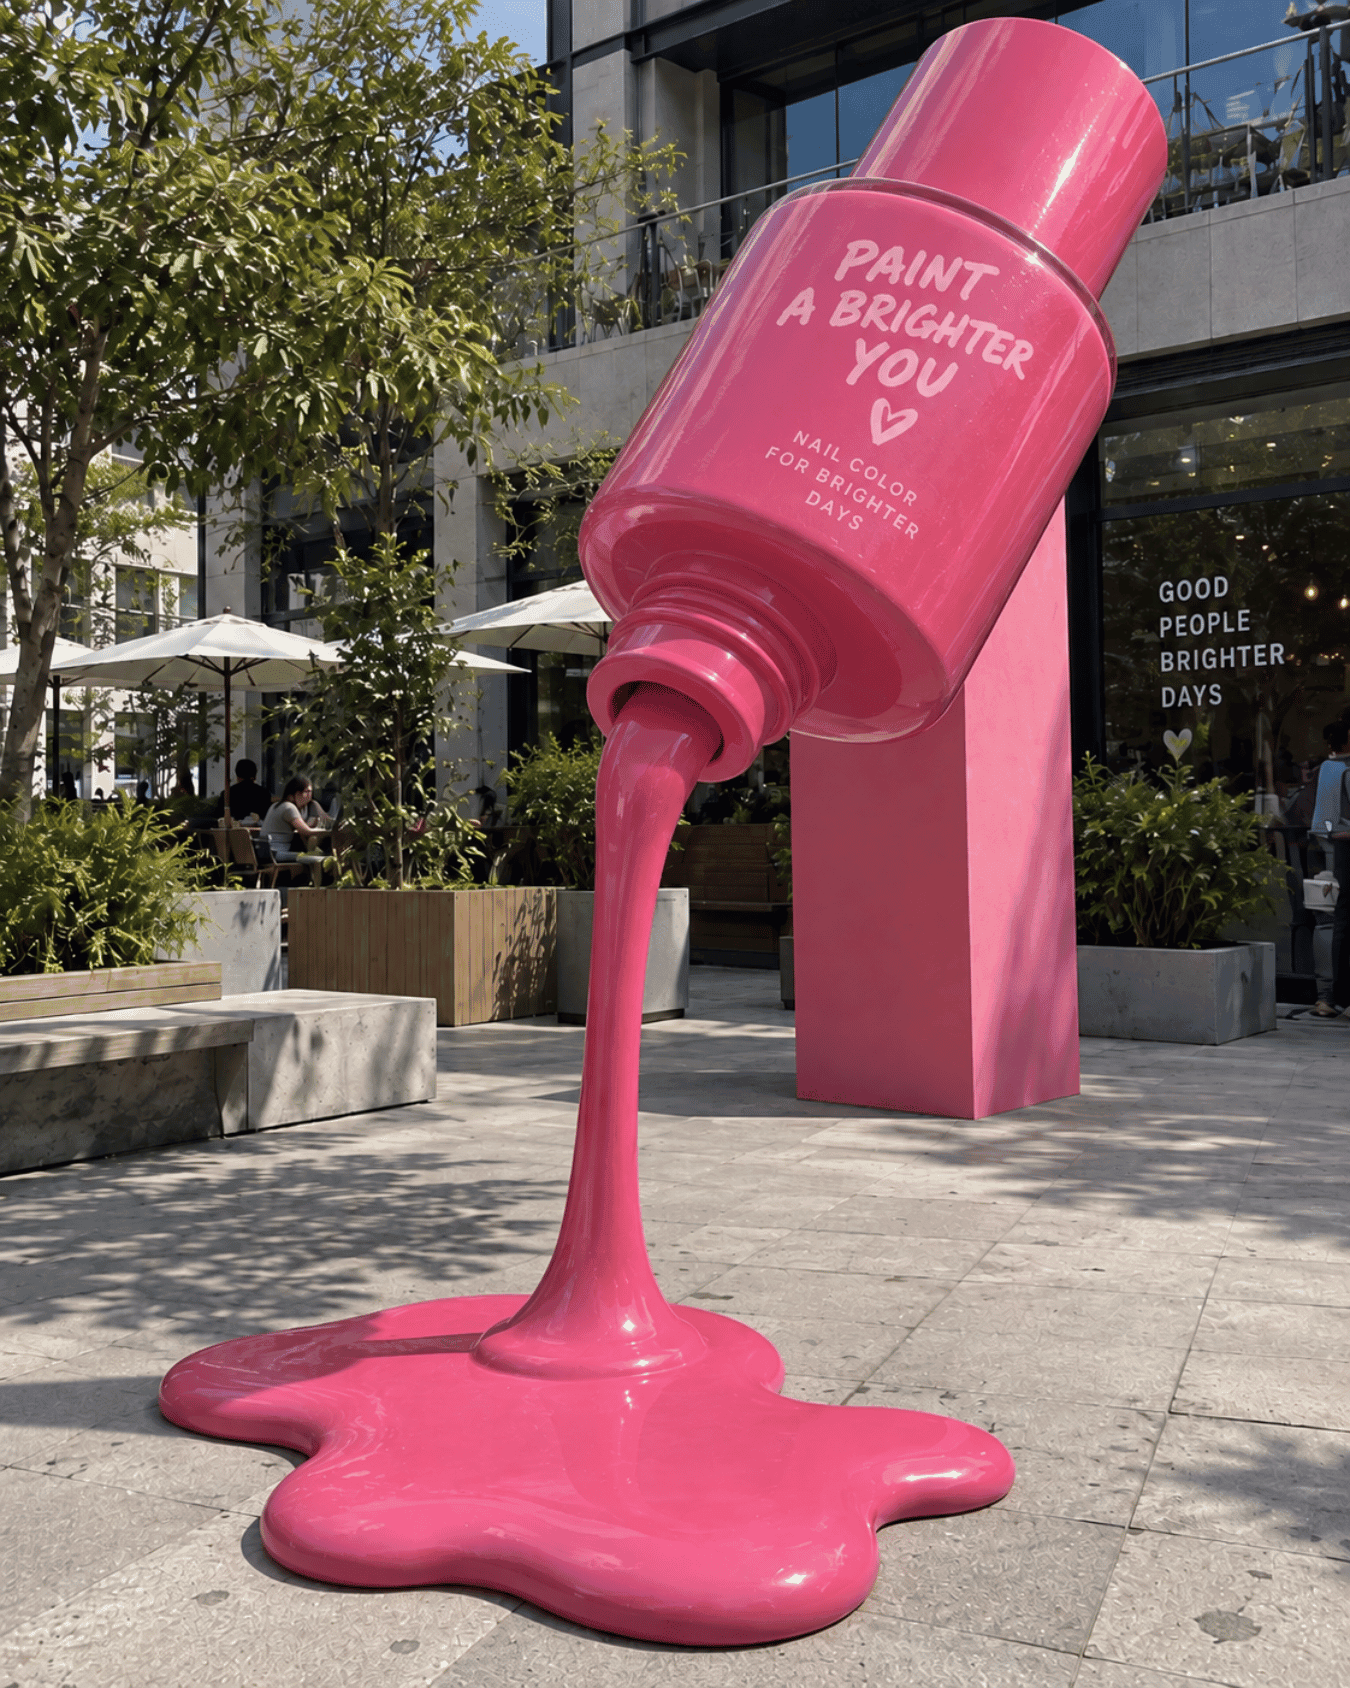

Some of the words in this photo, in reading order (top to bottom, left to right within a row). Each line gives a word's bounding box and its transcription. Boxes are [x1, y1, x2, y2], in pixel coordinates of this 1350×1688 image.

[834, 239, 1000, 301] PAINT
[776, 287, 816, 326] A
[829, 290, 1034, 380] BRIGHTER
[845, 338, 959, 398] YOU
[765, 446, 810, 474] FOR
[815, 467, 919, 539] BRIGHTER
[793, 430, 840, 463] NAIL
[849, 458, 918, 507] COLOR
[805, 490, 863, 530] DAYS
[1159, 576, 1229, 603] GOOD
[1160, 609, 1250, 638] PEOPLE
[1160, 643, 1285, 672] BRIGHTER
[1161, 684, 1222, 708] DAYS
